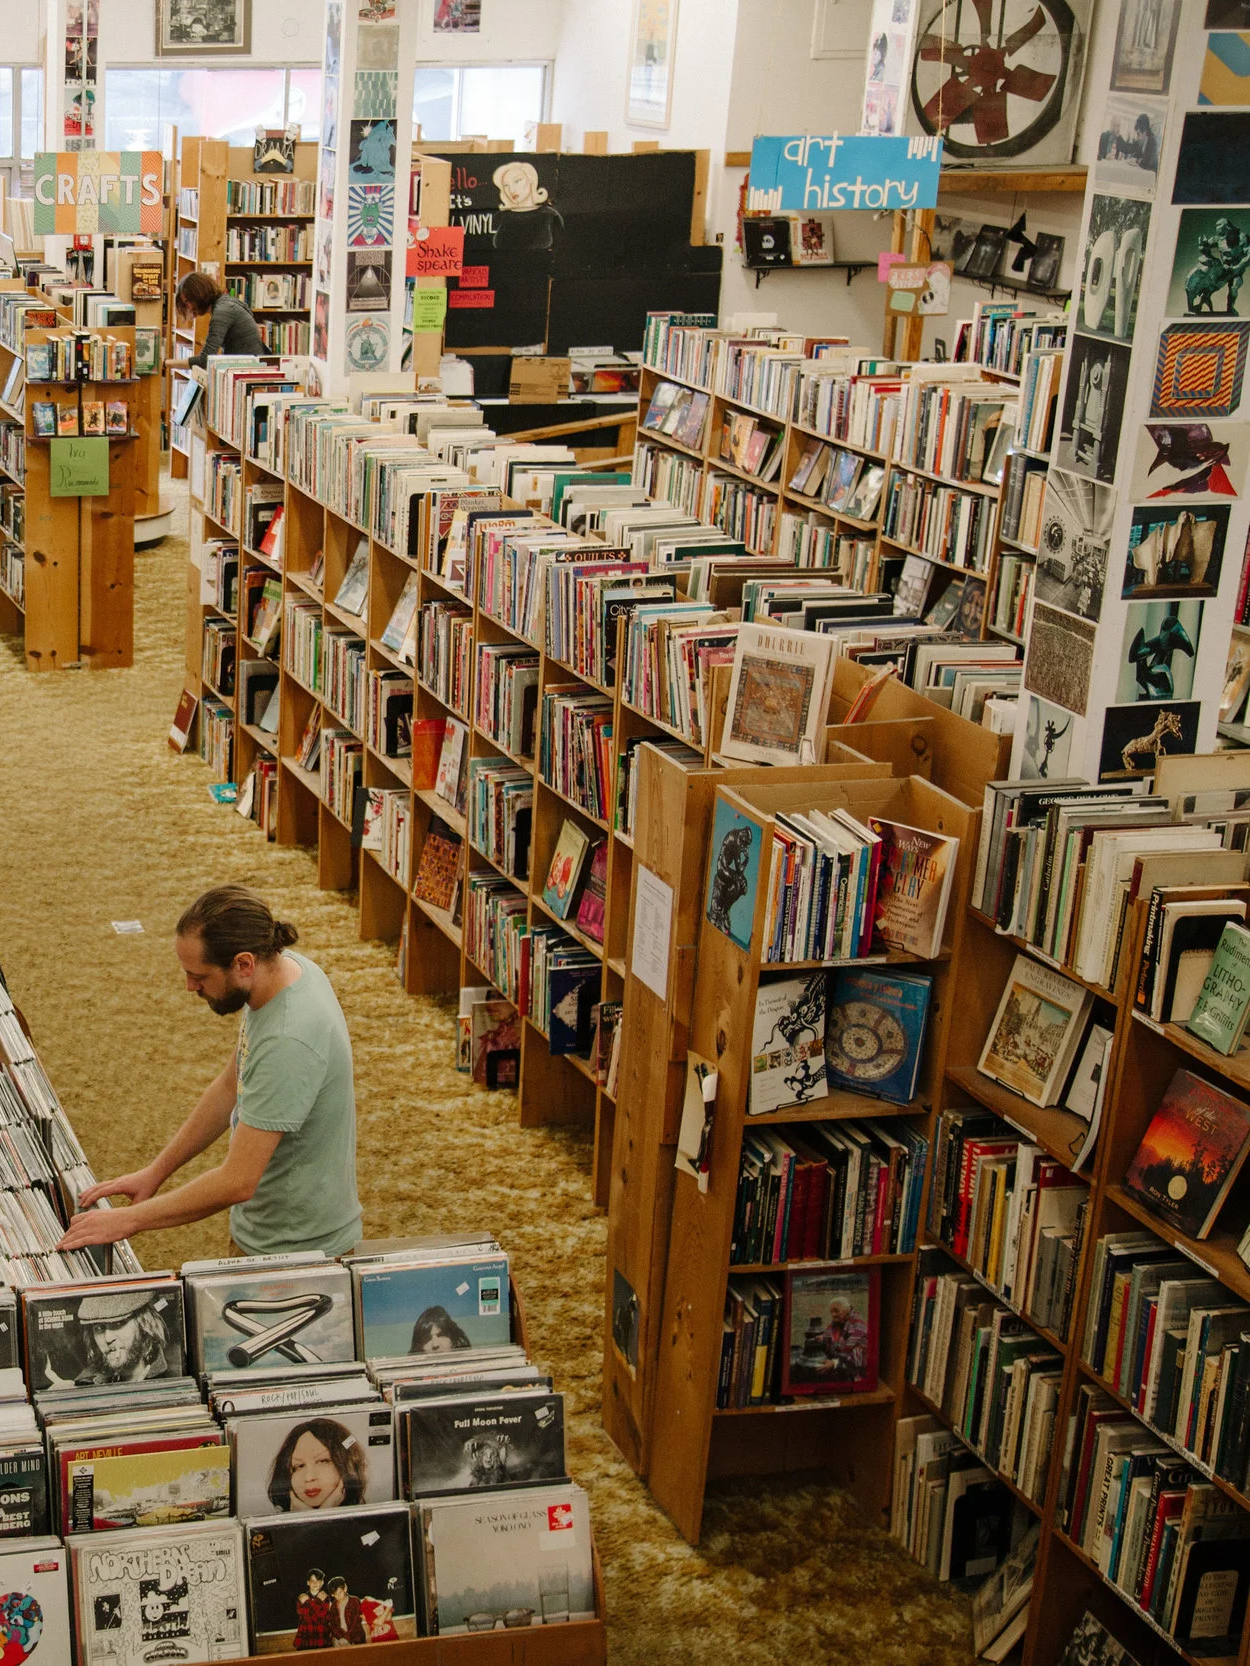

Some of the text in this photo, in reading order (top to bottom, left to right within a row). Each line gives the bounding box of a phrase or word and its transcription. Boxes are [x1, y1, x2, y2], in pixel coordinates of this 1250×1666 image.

[255, 141, 295, 160] DRAMA
[784, 131, 844, 168] art
[35, 173, 161, 206] CRAFTS
[450, 168, 487, 190] ello...
[803, 168, 919, 208] history
[460, 213, 498, 234] VINYL
[417, 242, 458, 259] Shake
[417, 258, 462, 273] speare
[574, 551, 615, 562] QUILTS
[1039, 794, 1076, 805] GEORGE
[1043, 854, 1053, 891] Cathelin
[893, 871, 925, 900] CLAY
[1143, 892, 1161, 956] Printmaking
[1220, 938, 1250, 968] Rudimen
[1023, 973, 1072, 1001] ENGRAVINGS
[1212, 964, 1246, 992] LITHO-
[1203, 976, 1244, 1012] GRAPHY
[1185, 1110, 1219, 1135] WEST
[1162, 1194, 1180, 1210] TYLER
[261, 1389, 319, 1405] ROCK/POP/SOUL
[454, 1414, 523, 1428] Full Moon Fever
[21, 1459, 41, 1472] MIND
[75, 1447, 124, 1461] ART NEVILLE
[1096, 1456, 1114, 1533] GREAT PRINTS
[3, 1511, 31, 1522] BEST
[475, 1514, 506, 1524] SEASON
[519, 1510, 548, 1519] GLASS
[89, 1544, 190, 1584] NORTHERN
[158, 1558, 227, 1592] DREAM
